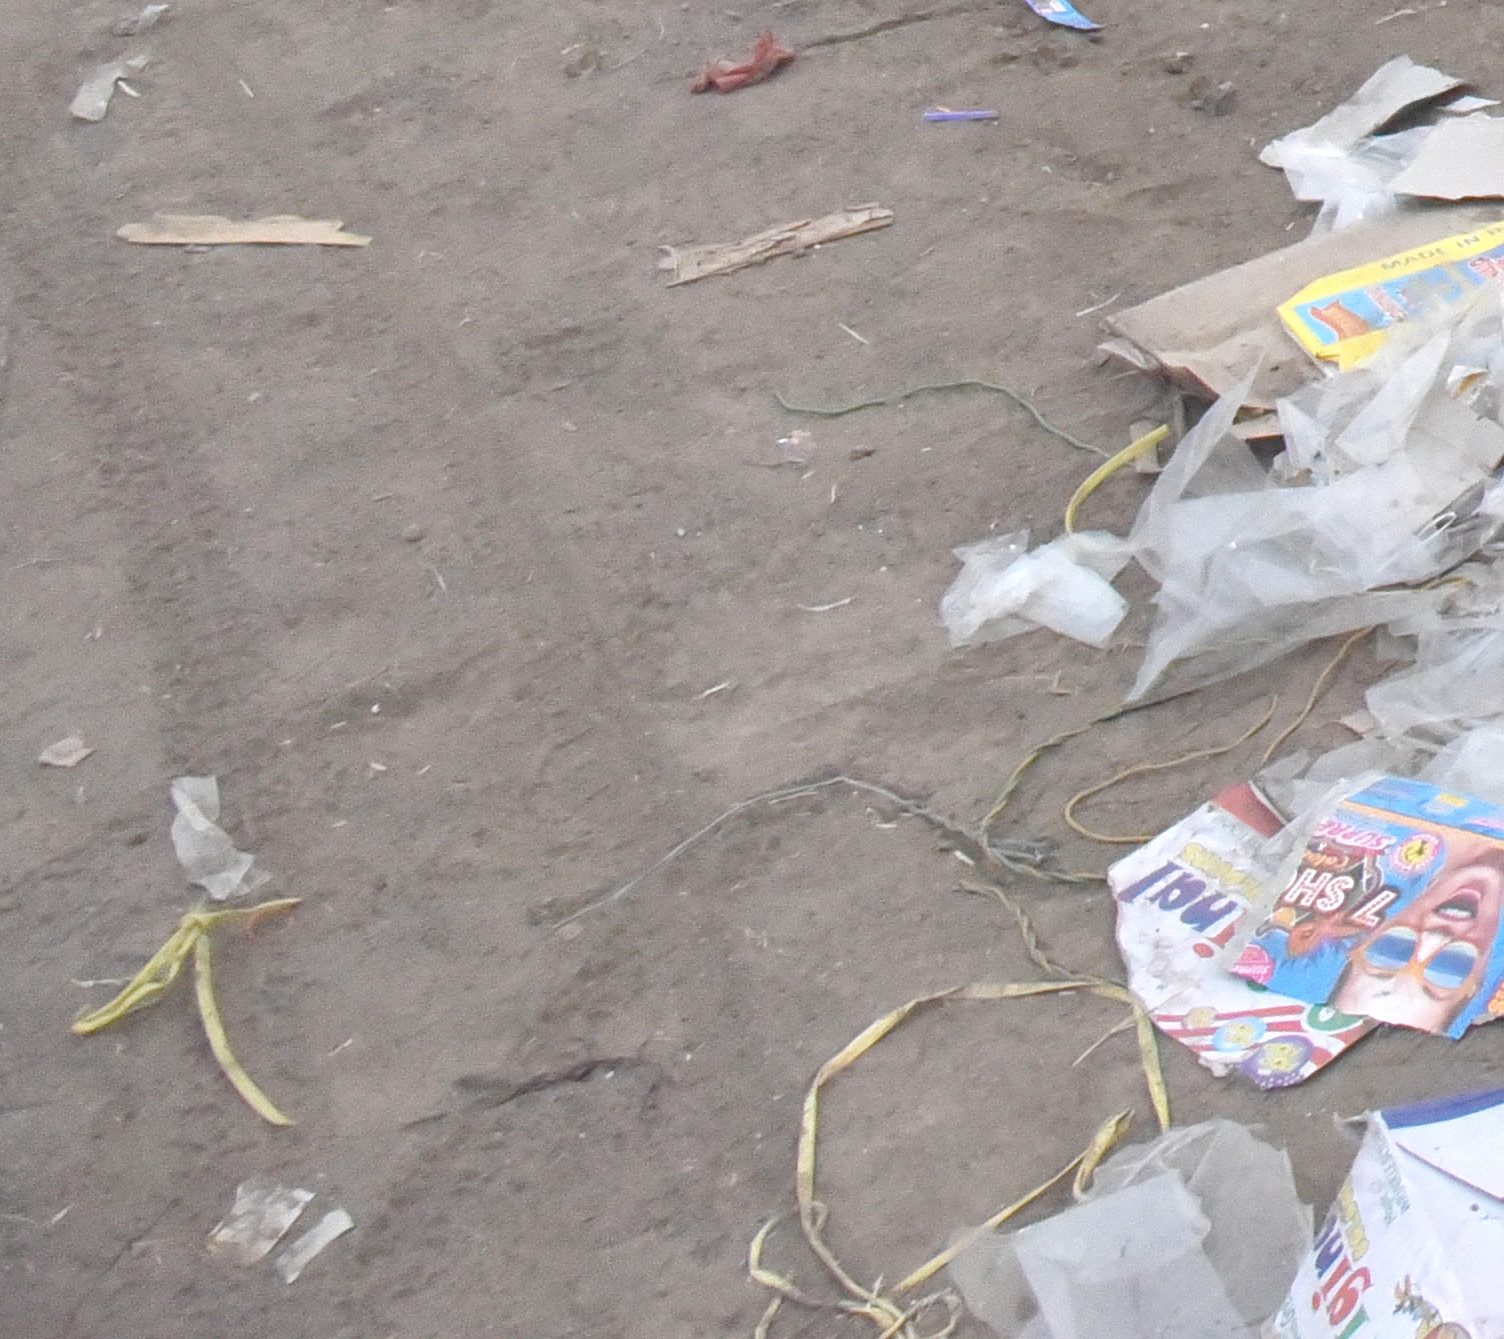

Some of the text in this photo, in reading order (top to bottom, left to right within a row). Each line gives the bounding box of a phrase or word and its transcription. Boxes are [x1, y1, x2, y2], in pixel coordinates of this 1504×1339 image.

[1379, 246, 1446, 271] MADE
[1456, 234, 1480, 249] IN
[1285, 867, 1399, 929] 7 SH
